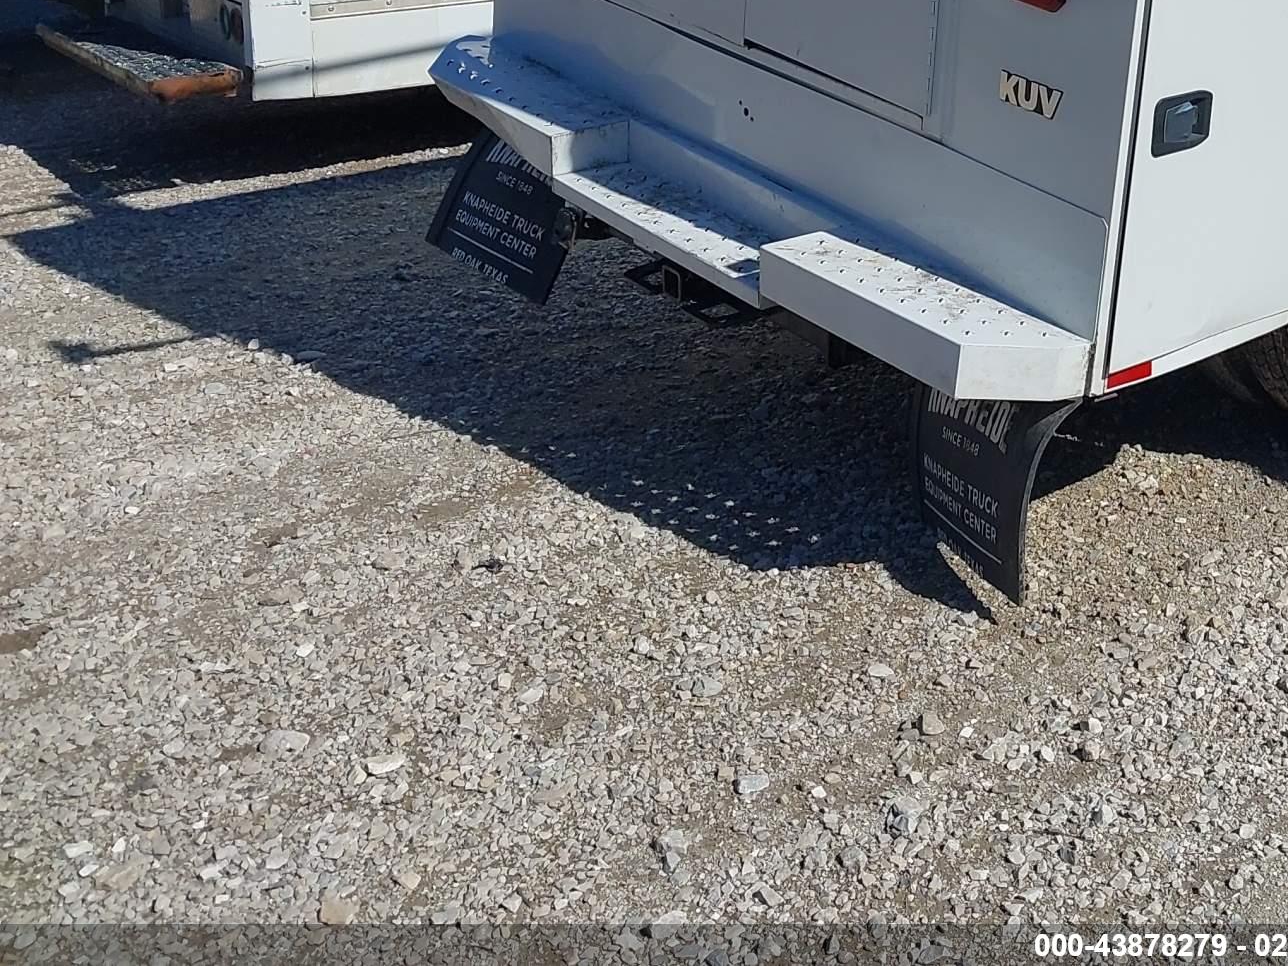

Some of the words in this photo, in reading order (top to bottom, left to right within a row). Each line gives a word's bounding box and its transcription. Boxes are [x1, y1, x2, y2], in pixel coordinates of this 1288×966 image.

[999, 68, 1064, 120] KUV
[495, 170, 516, 188] SINCE
[455, 209, 500, 241] EQUIPMENT
[500, 231, 537, 260] CENTER
[462, 190, 511, 224] KNAPHEIDE
[511, 214, 547, 242] TRUCK
[465, 254, 482, 272] OAK
[482, 263, 509, 285] TEXAS
[941, 425, 962, 447] SINCE
[923, 452, 965, 497] KNAPHEIDE
[967, 484, 999, 519] TRUCK
[924, 476, 962, 519] EQUIPMENT
[963, 508, 997, 545] CENTER
